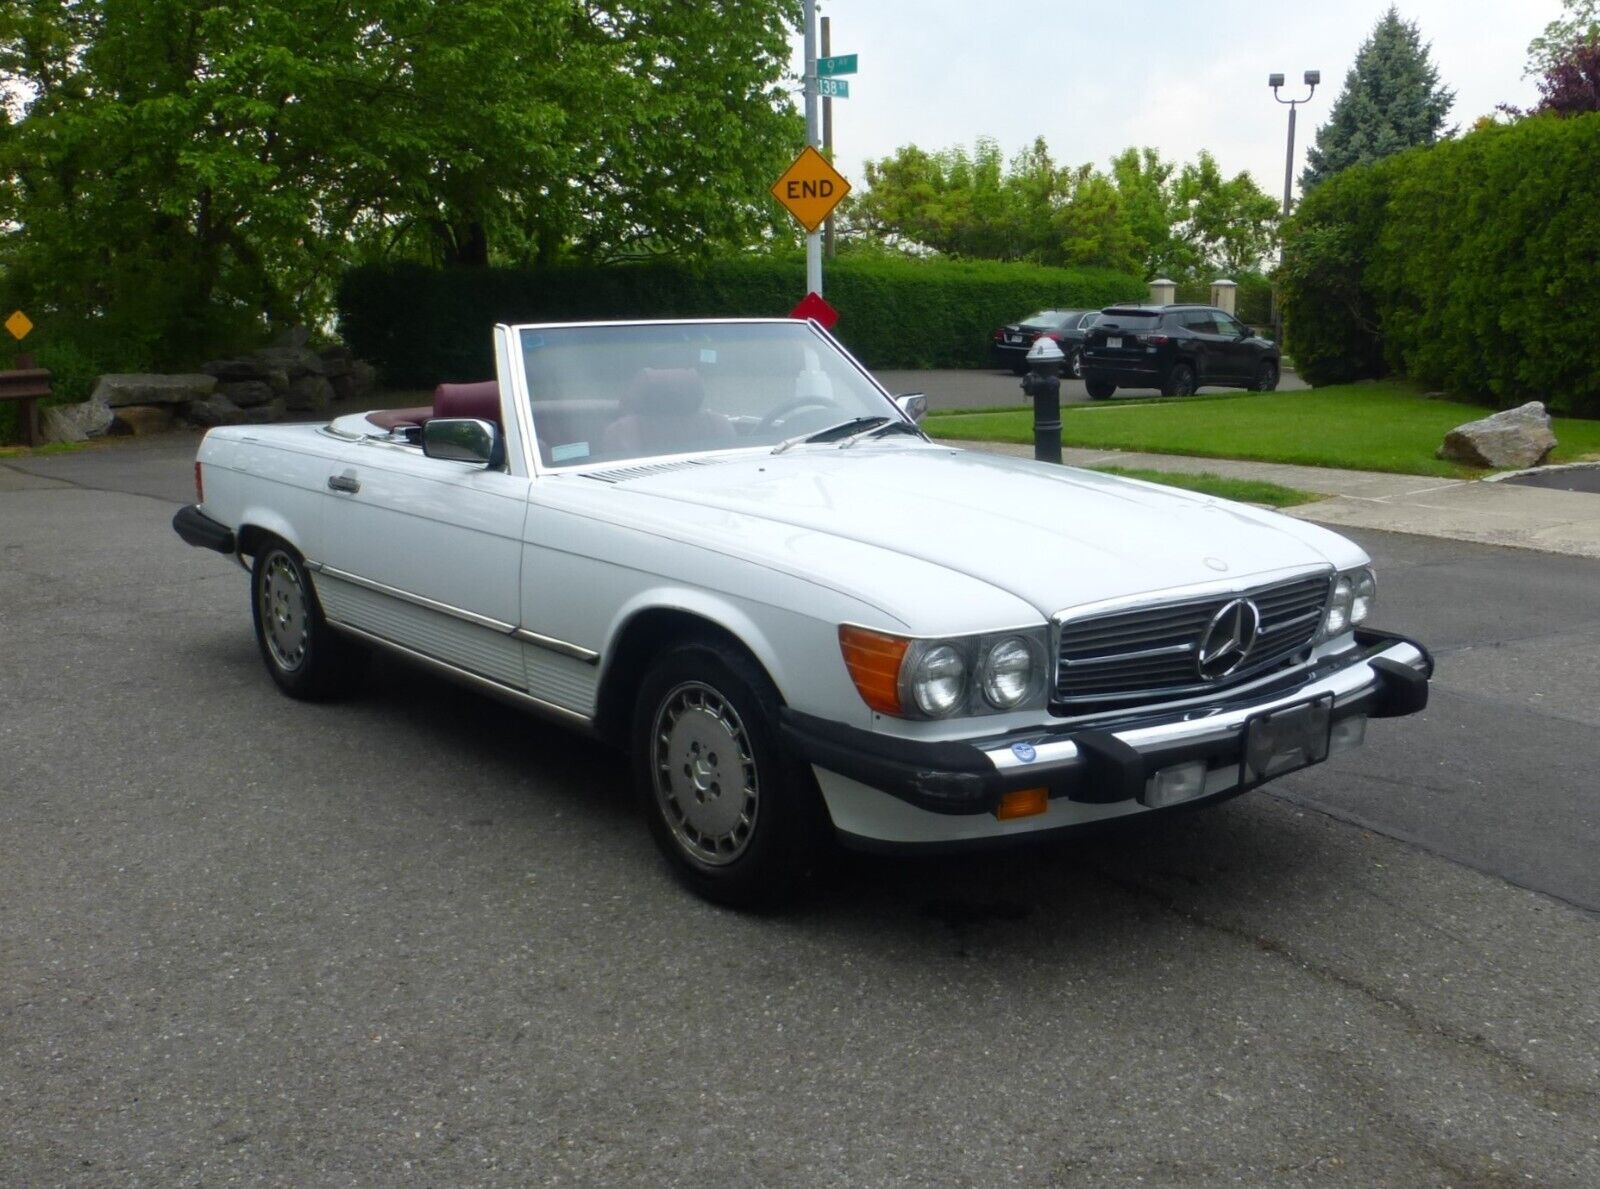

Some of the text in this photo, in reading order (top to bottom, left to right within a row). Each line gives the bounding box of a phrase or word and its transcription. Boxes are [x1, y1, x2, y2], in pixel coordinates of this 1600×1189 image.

[827, 60, 835, 73] 9
[819, 79, 837, 95] 138
[787, 180, 834, 199] END
